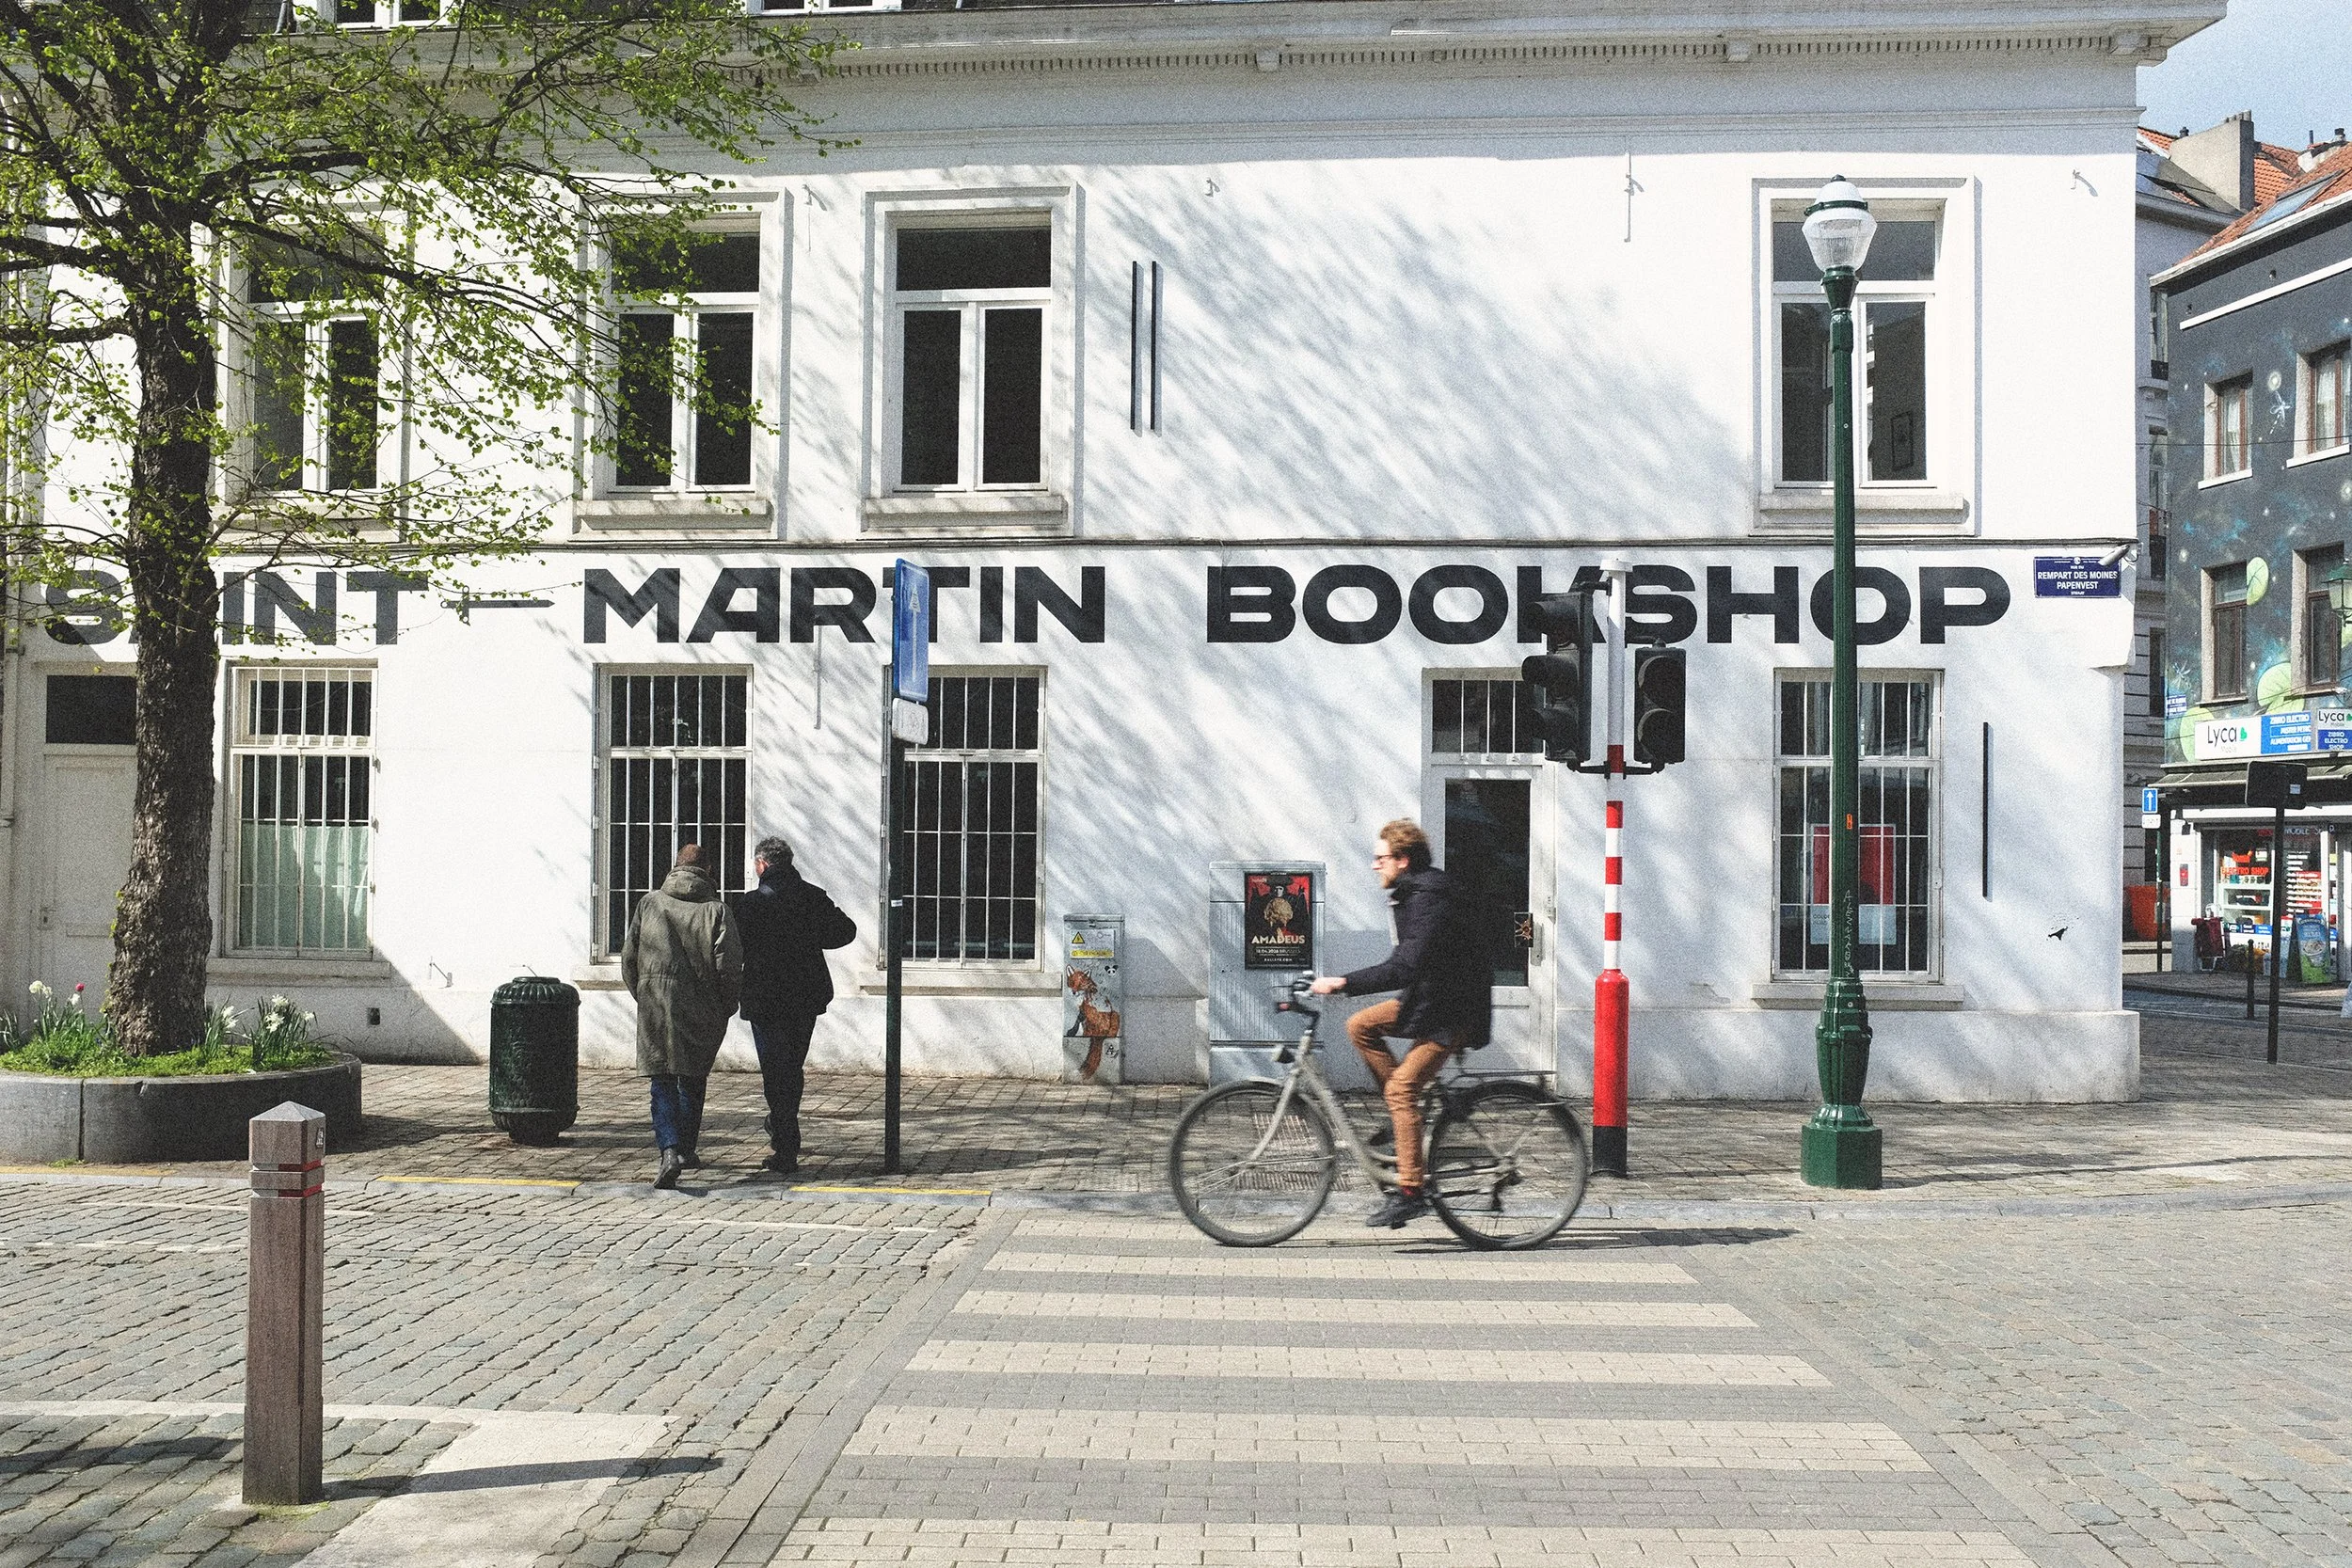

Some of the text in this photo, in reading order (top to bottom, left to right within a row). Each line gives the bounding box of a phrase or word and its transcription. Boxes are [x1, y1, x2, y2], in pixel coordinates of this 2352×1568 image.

[2037, 571, 2118, 579] REMPART DES MOINES
[2057, 581, 2099, 590] PAPENVEST
[43, 569, 429, 646] SINT
[583, 565, 1105, 644] MARTIN
[2318, 710, 2344, 723] Lyca
[2207, 725, 2237, 748] Lyca
[2284, 827, 2310, 835] MOBILE
[2221, 866, 2269, 876] ELECTRO SHOP
[1251, 935, 1306, 944] AMADEUS
